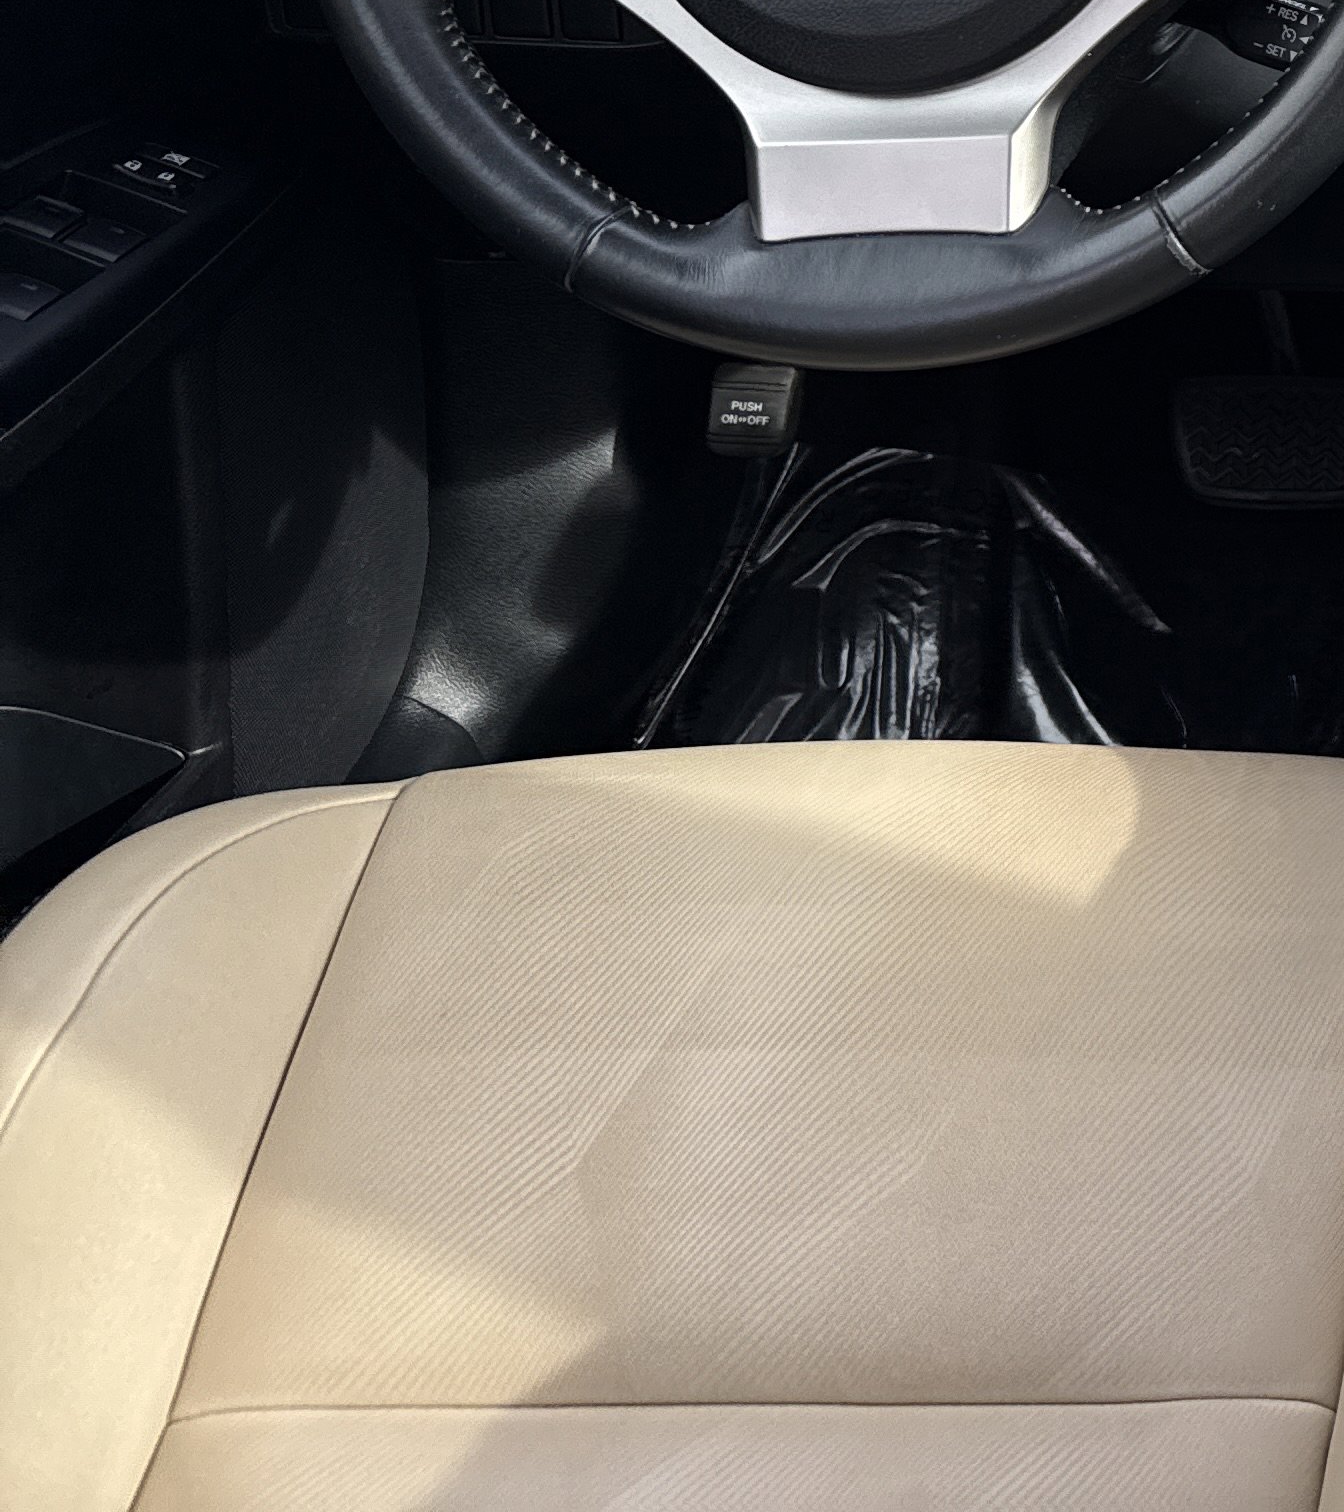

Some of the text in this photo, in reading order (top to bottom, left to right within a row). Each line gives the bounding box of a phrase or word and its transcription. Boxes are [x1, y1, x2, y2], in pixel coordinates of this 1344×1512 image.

[1278, 6, 1299, 22] RES
[1265, 43, 1287, 58] SET
[731, 400, 763, 412] PUSH
